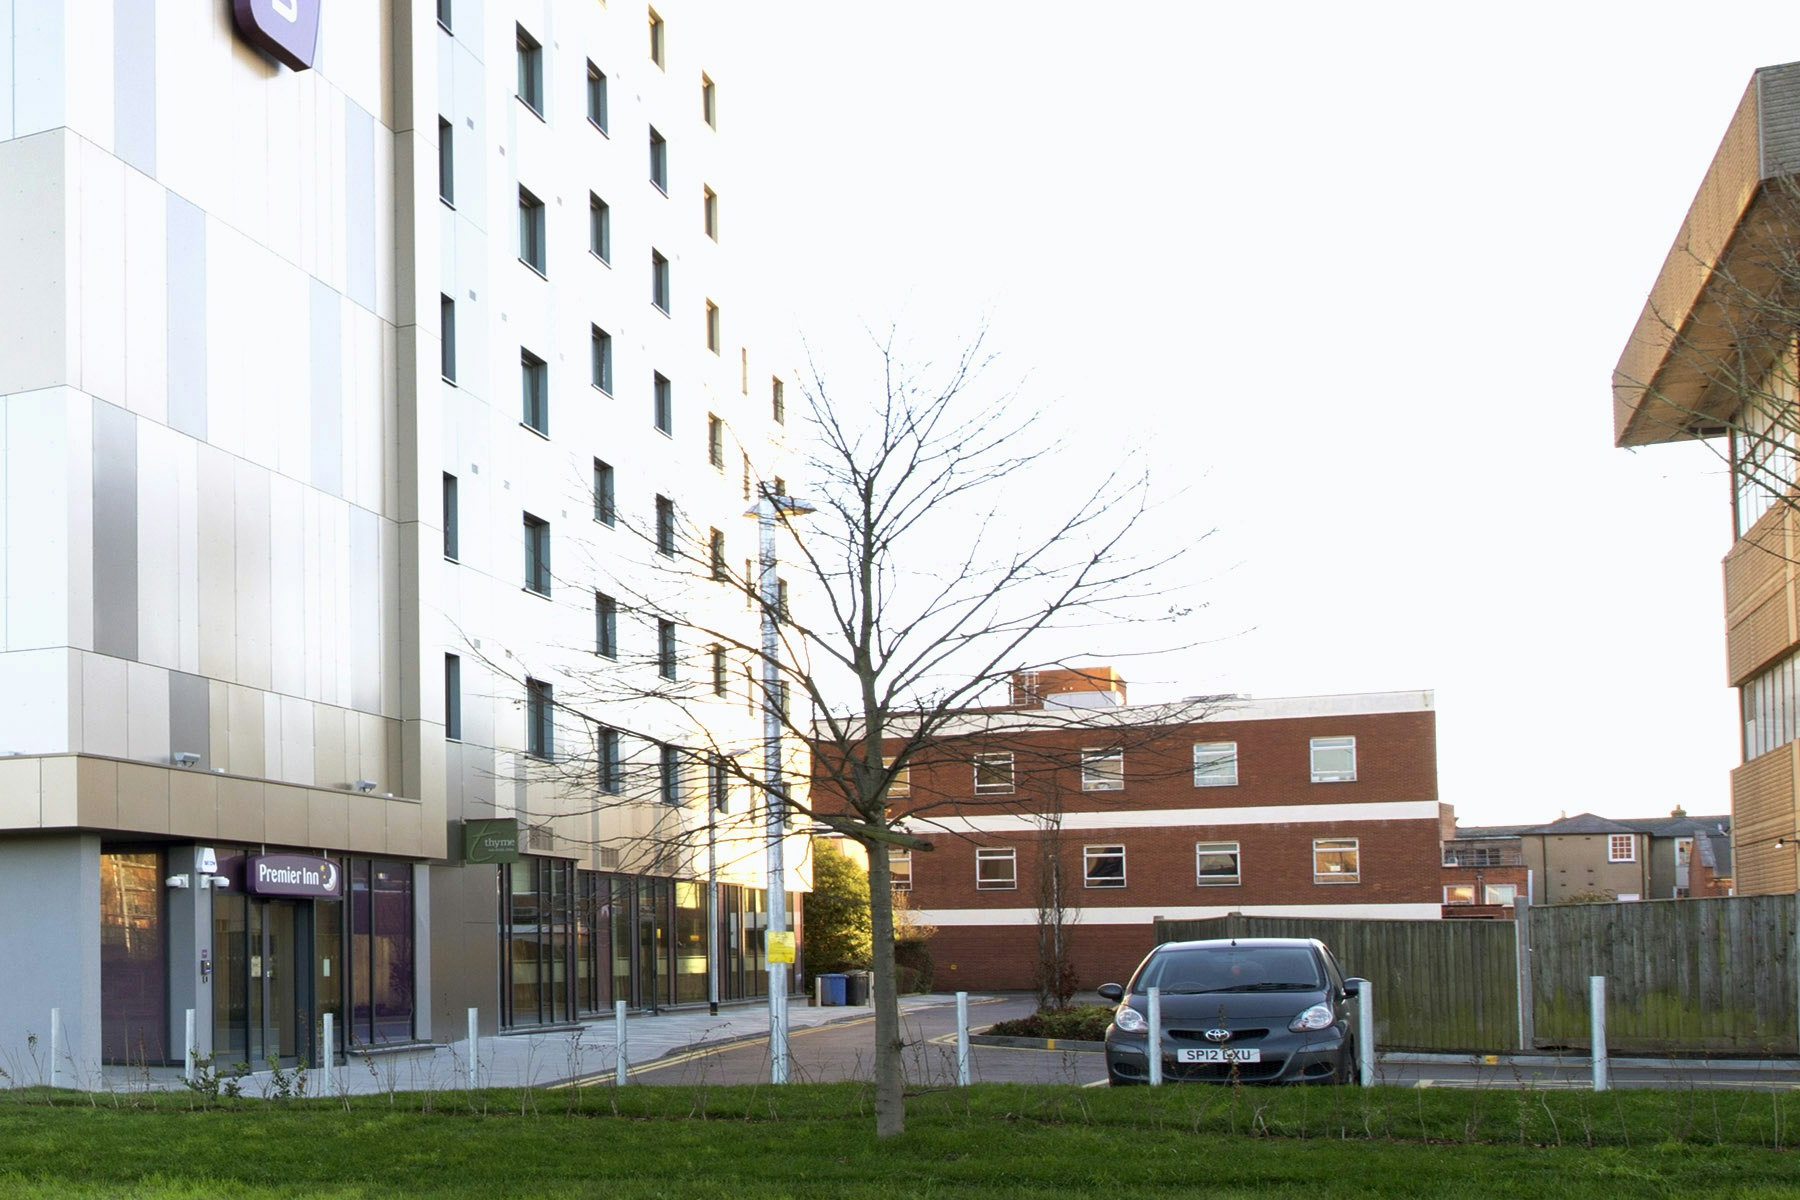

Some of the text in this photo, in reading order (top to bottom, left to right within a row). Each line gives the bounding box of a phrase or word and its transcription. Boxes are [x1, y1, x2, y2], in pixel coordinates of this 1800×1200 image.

[484, 838, 516, 848] thyme
[259, 863, 319, 886] Premier Inn
[1186, 1049, 1218, 1061] SP12
